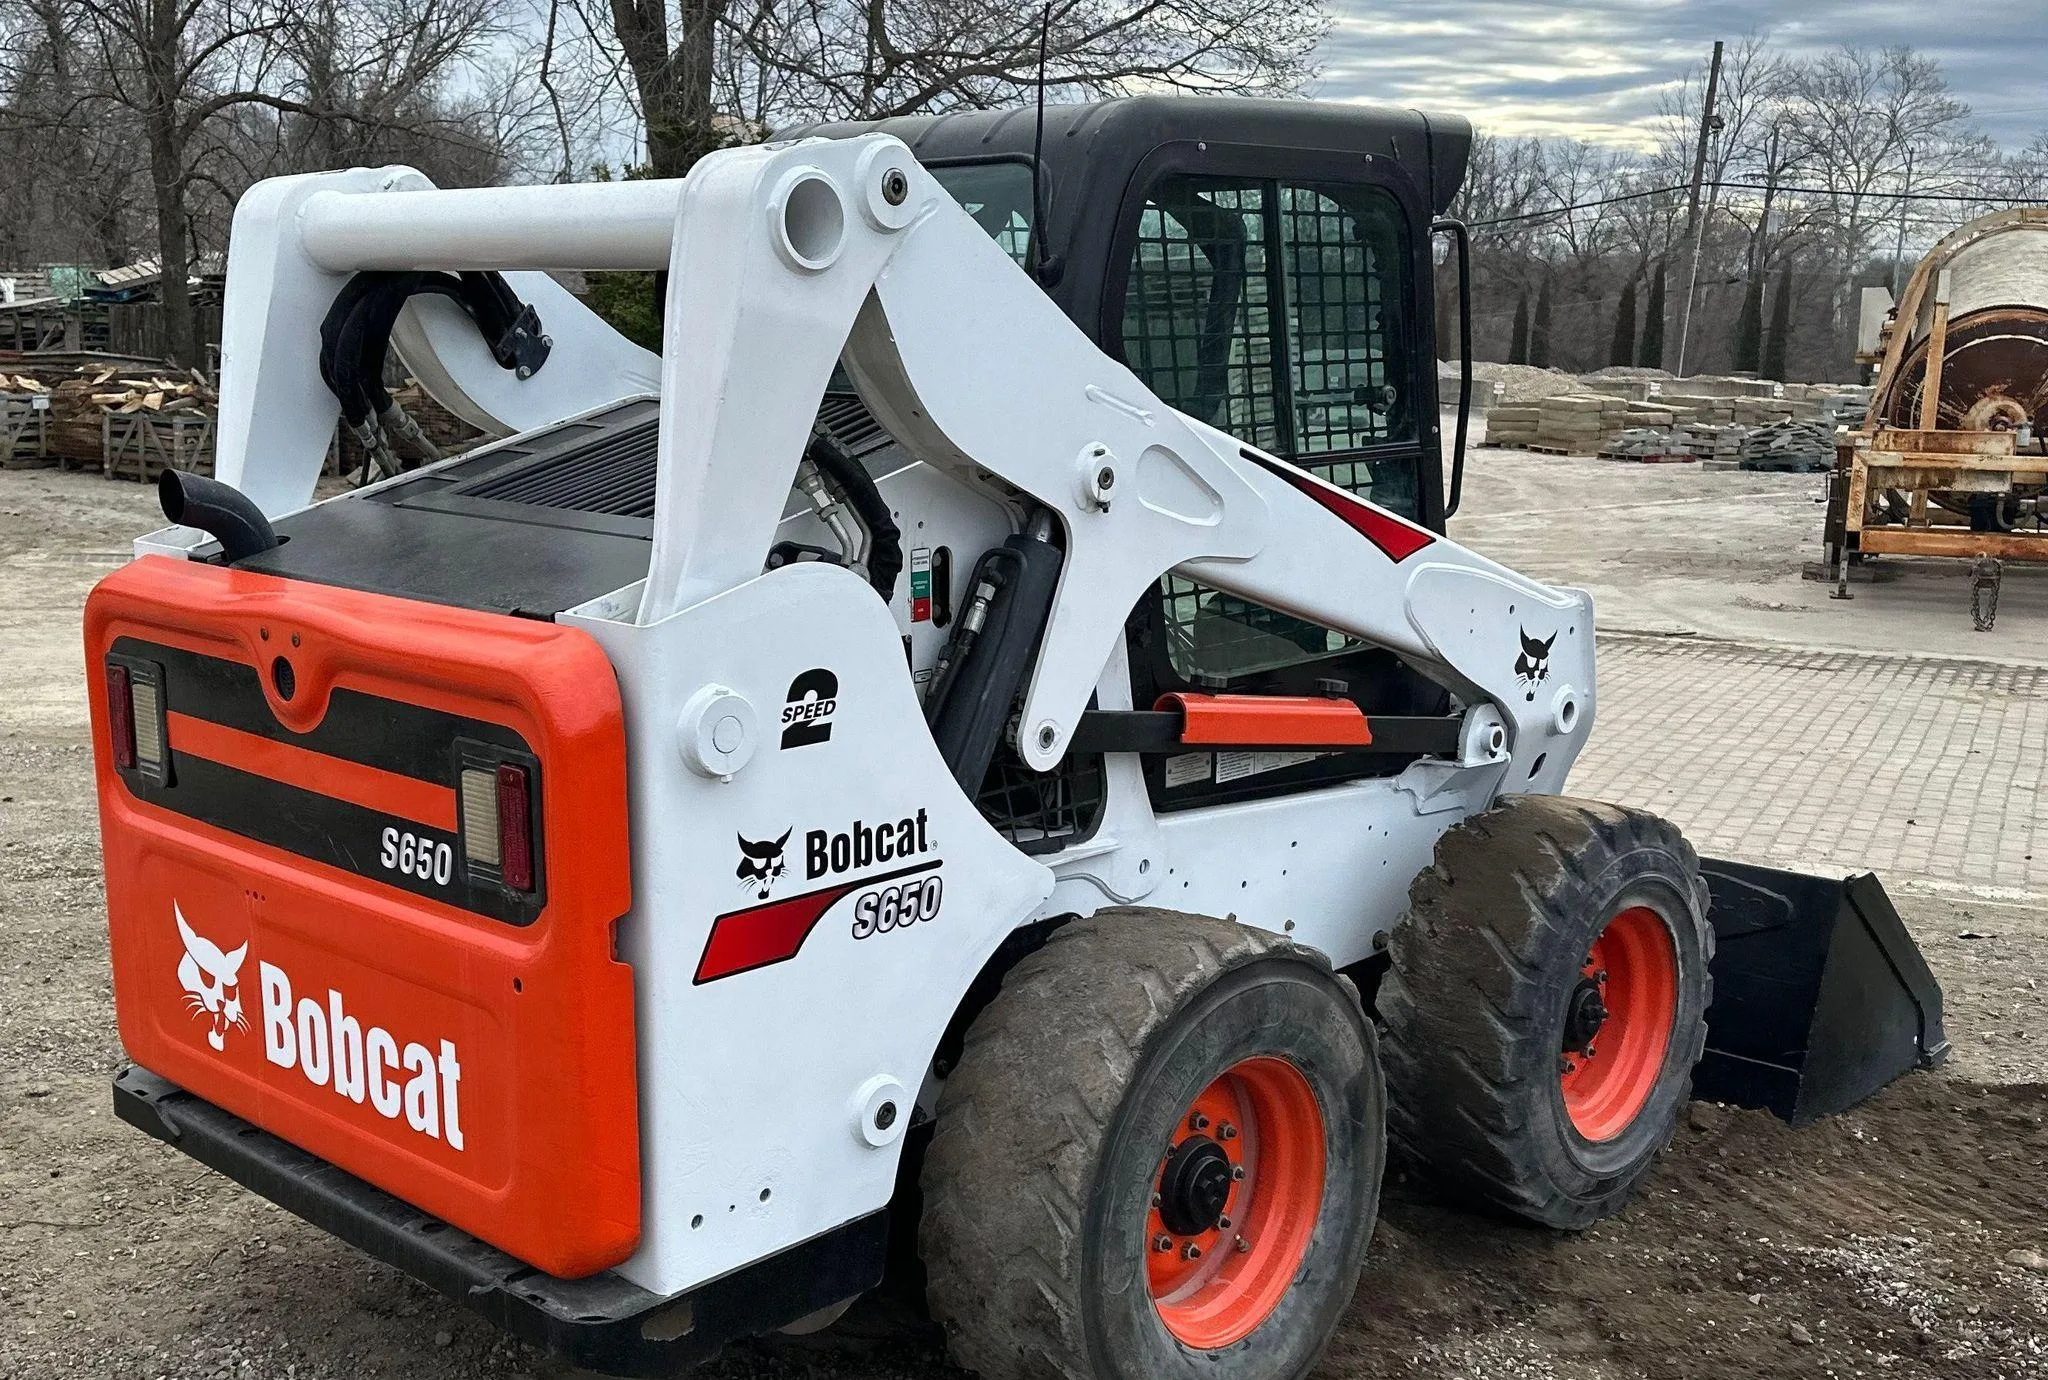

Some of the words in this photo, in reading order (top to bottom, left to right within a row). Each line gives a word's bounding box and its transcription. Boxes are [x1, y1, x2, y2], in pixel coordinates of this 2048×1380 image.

[780, 668, 838, 750] 2
[781, 700, 836, 723] SPEED
[380, 827, 453, 886] S650
[852, 876, 942, 940] S650
[260, 960, 464, 1151] Bobcat
